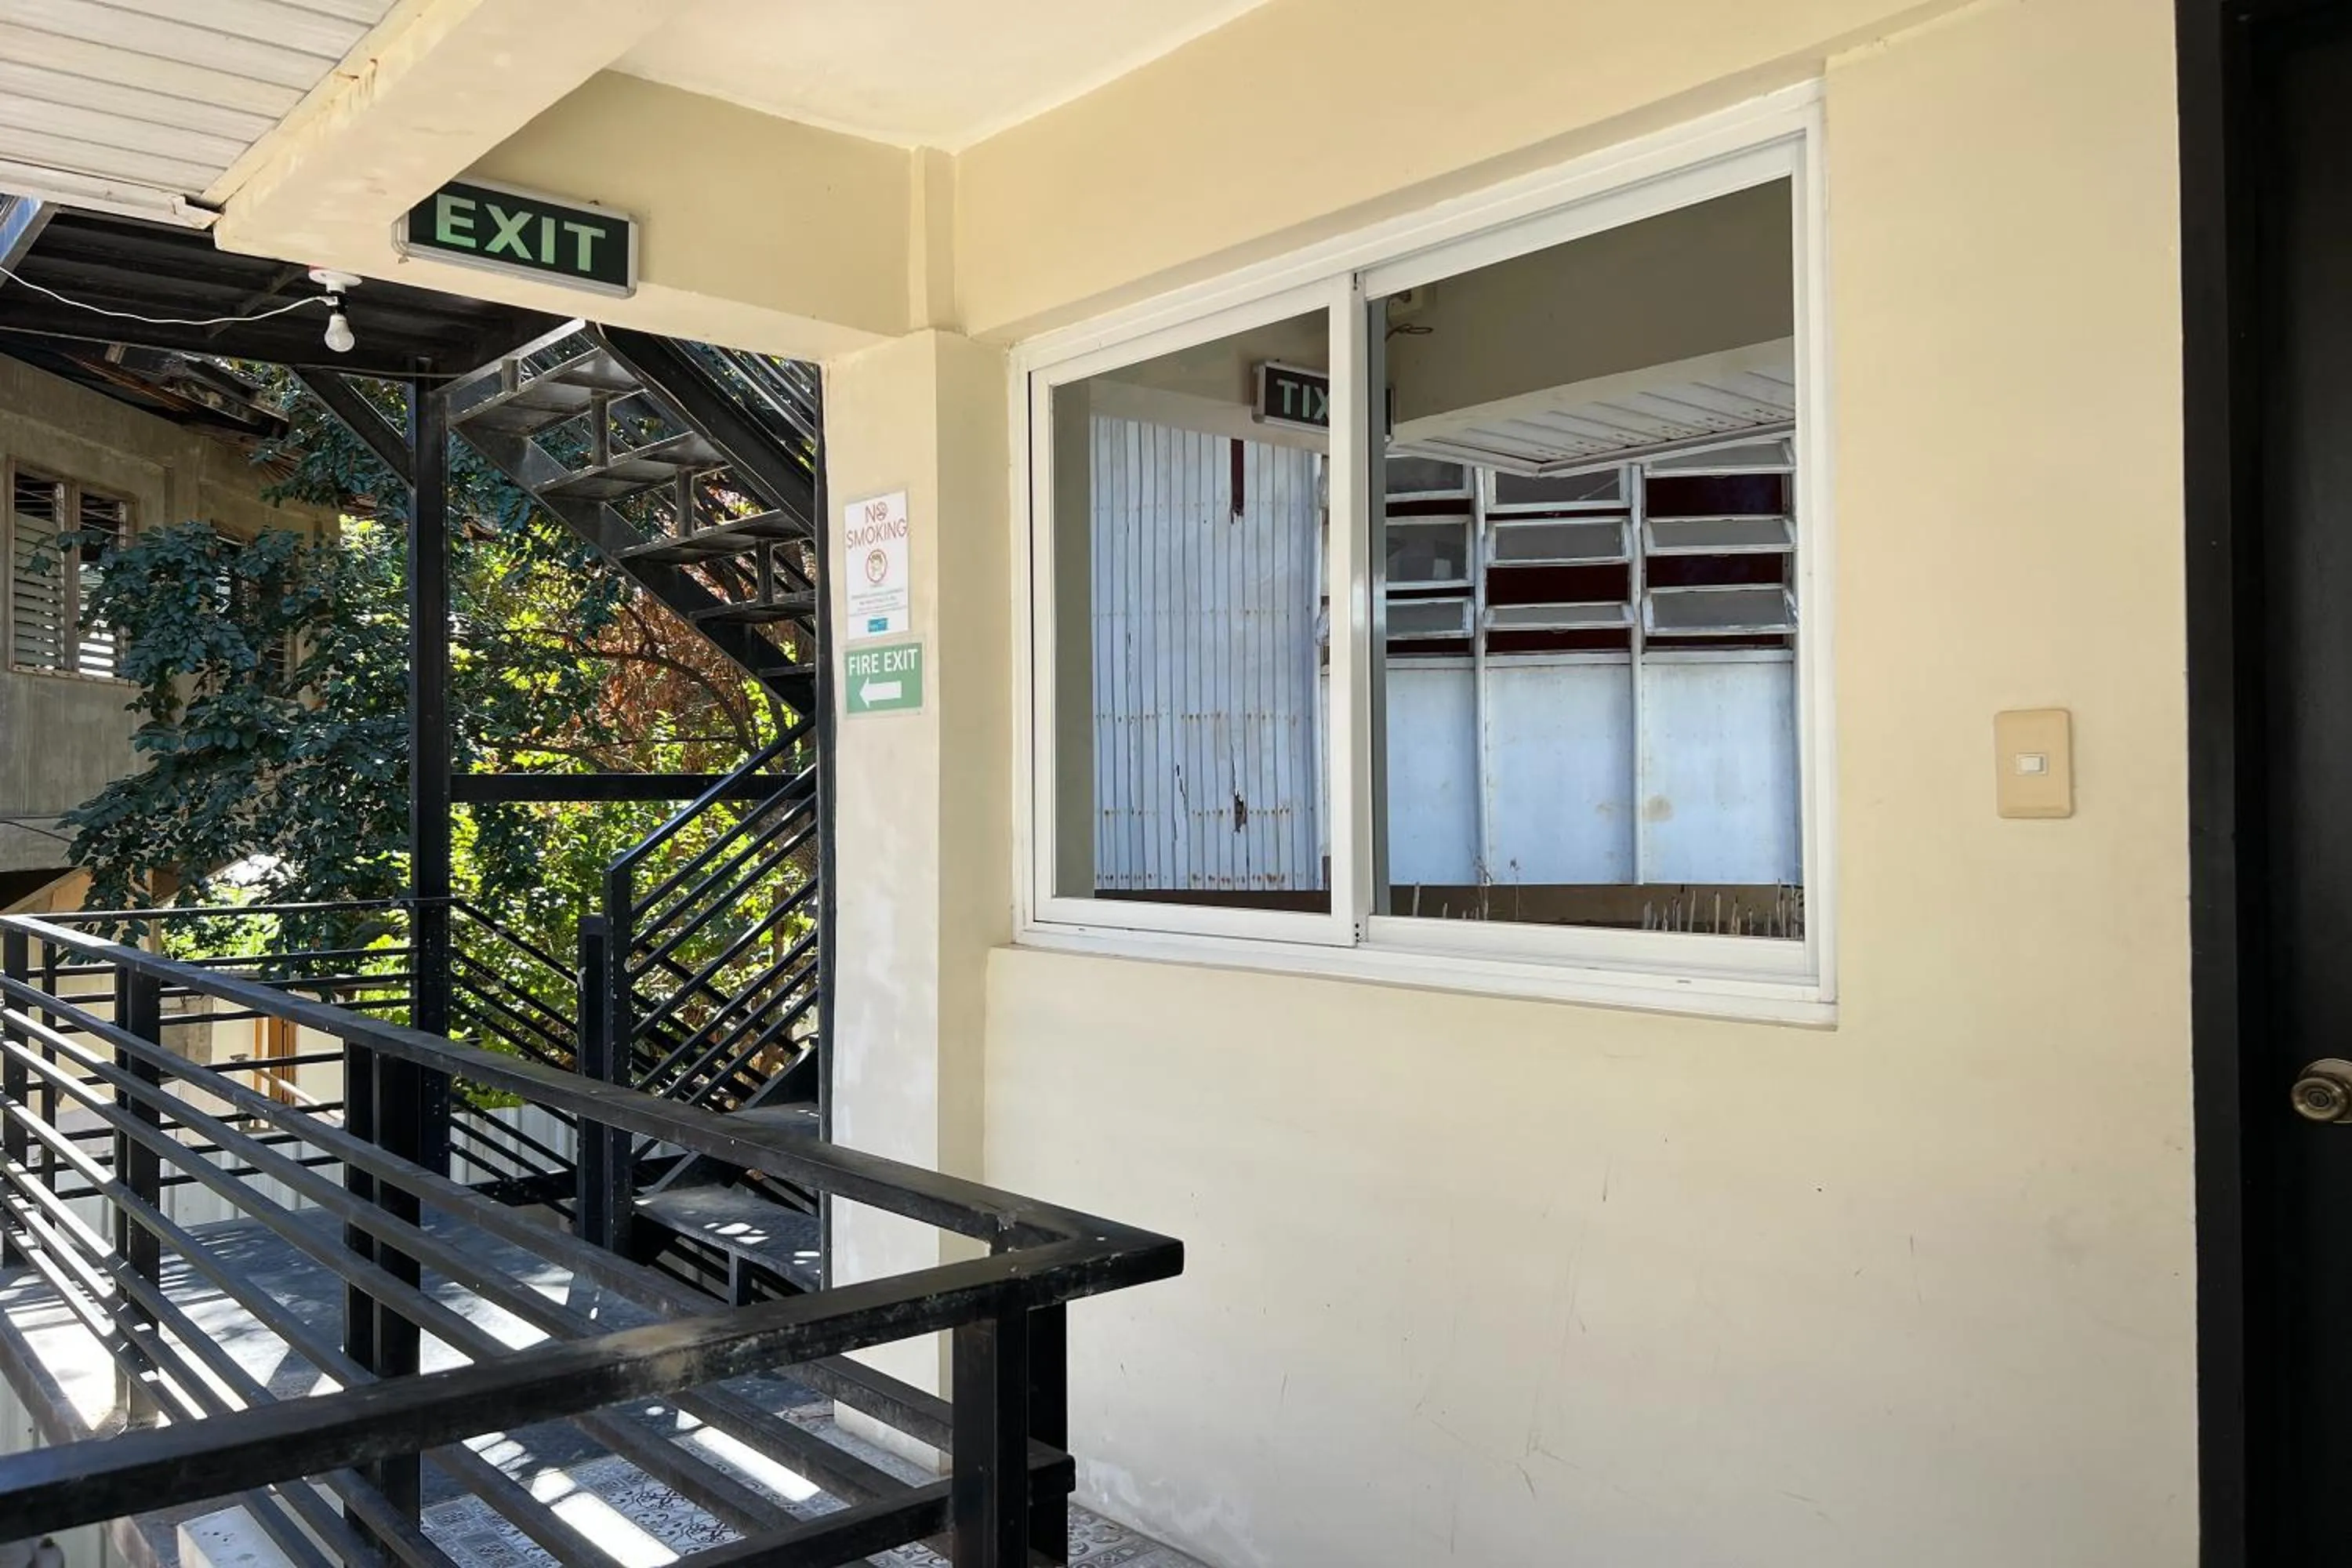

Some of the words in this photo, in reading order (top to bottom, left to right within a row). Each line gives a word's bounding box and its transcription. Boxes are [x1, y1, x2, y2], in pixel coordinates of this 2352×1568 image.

[436, 193, 606, 272] EXIT
[865, 502, 888, 523] NO
[846, 518, 907, 550] SMOKING
[848, 653, 880, 677] FIRE
[884, 648, 918, 672] EXIT
